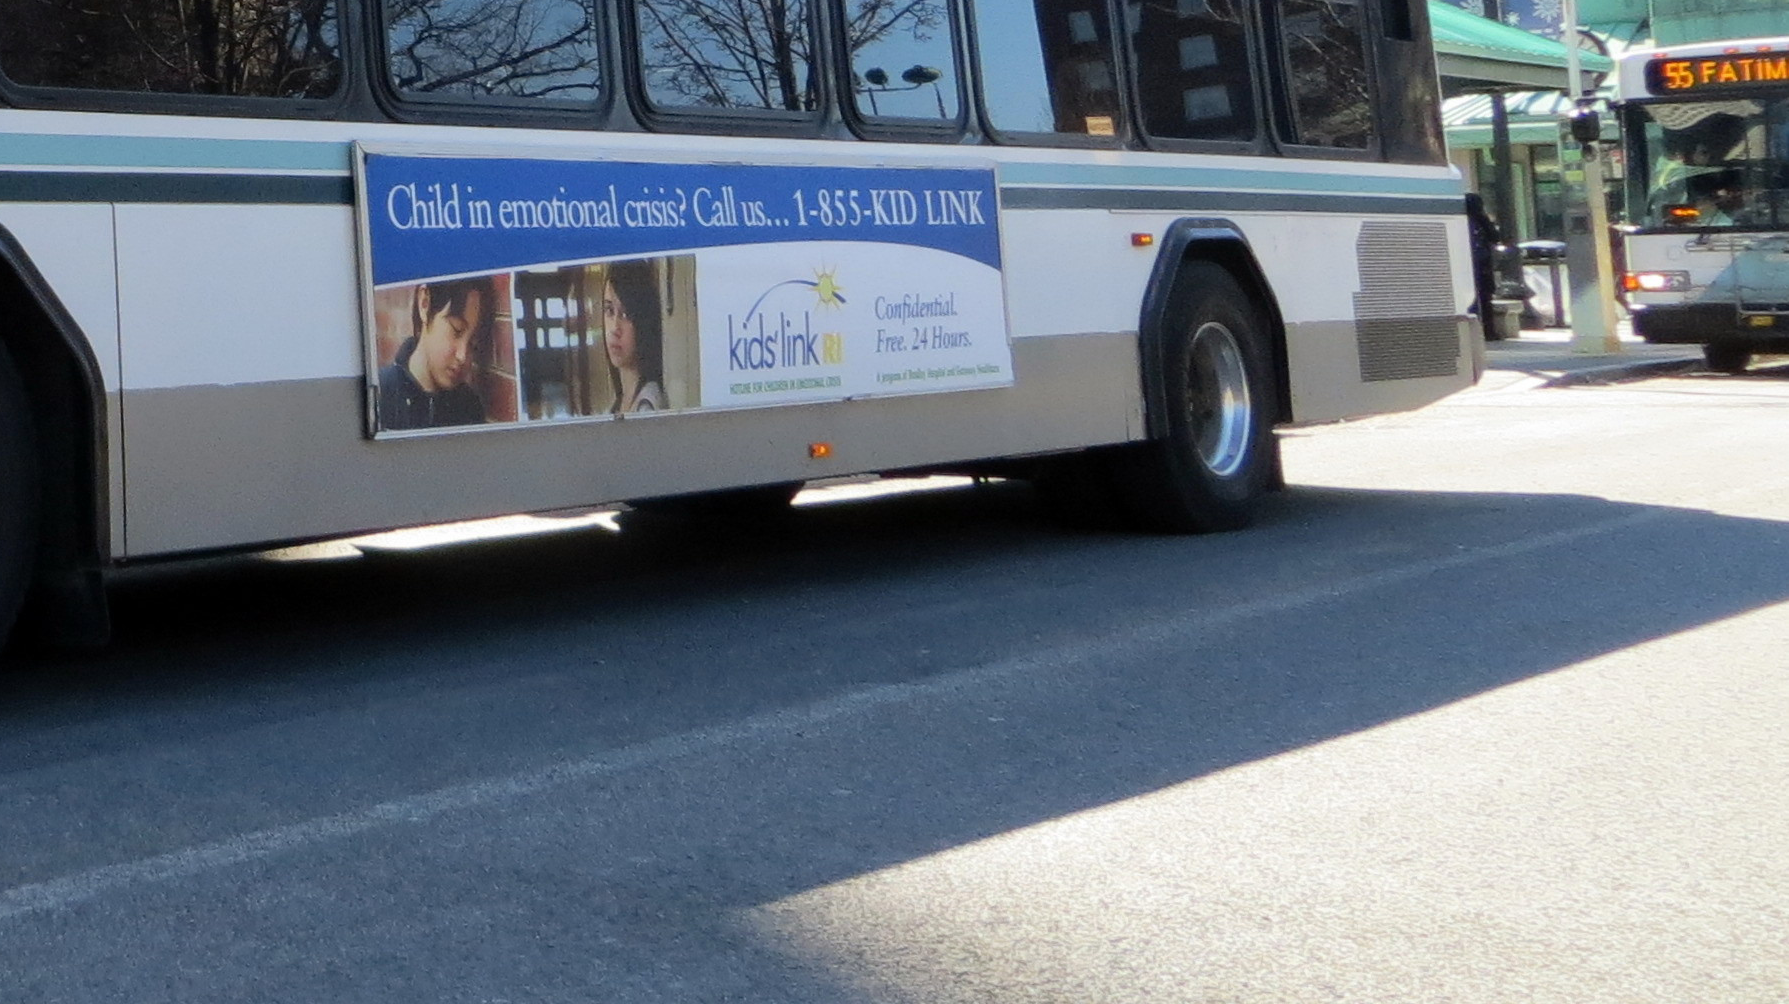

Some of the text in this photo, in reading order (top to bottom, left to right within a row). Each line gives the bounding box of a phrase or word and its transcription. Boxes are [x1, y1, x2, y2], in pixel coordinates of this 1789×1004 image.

[1664, 60, 1695, 89] 55
[387, 182, 462, 229] Child
[467, 185, 495, 229] in
[499, 184, 620, 228] emotional
[624, 186, 687, 228] crisis?
[693, 185, 739, 227] Call
[792, 188, 918, 227] 1-855-KID
[922, 189, 986, 226] LINK
[874, 292, 959, 325] Confidential.
[875, 325, 972, 353] Free. 24 Hours.
